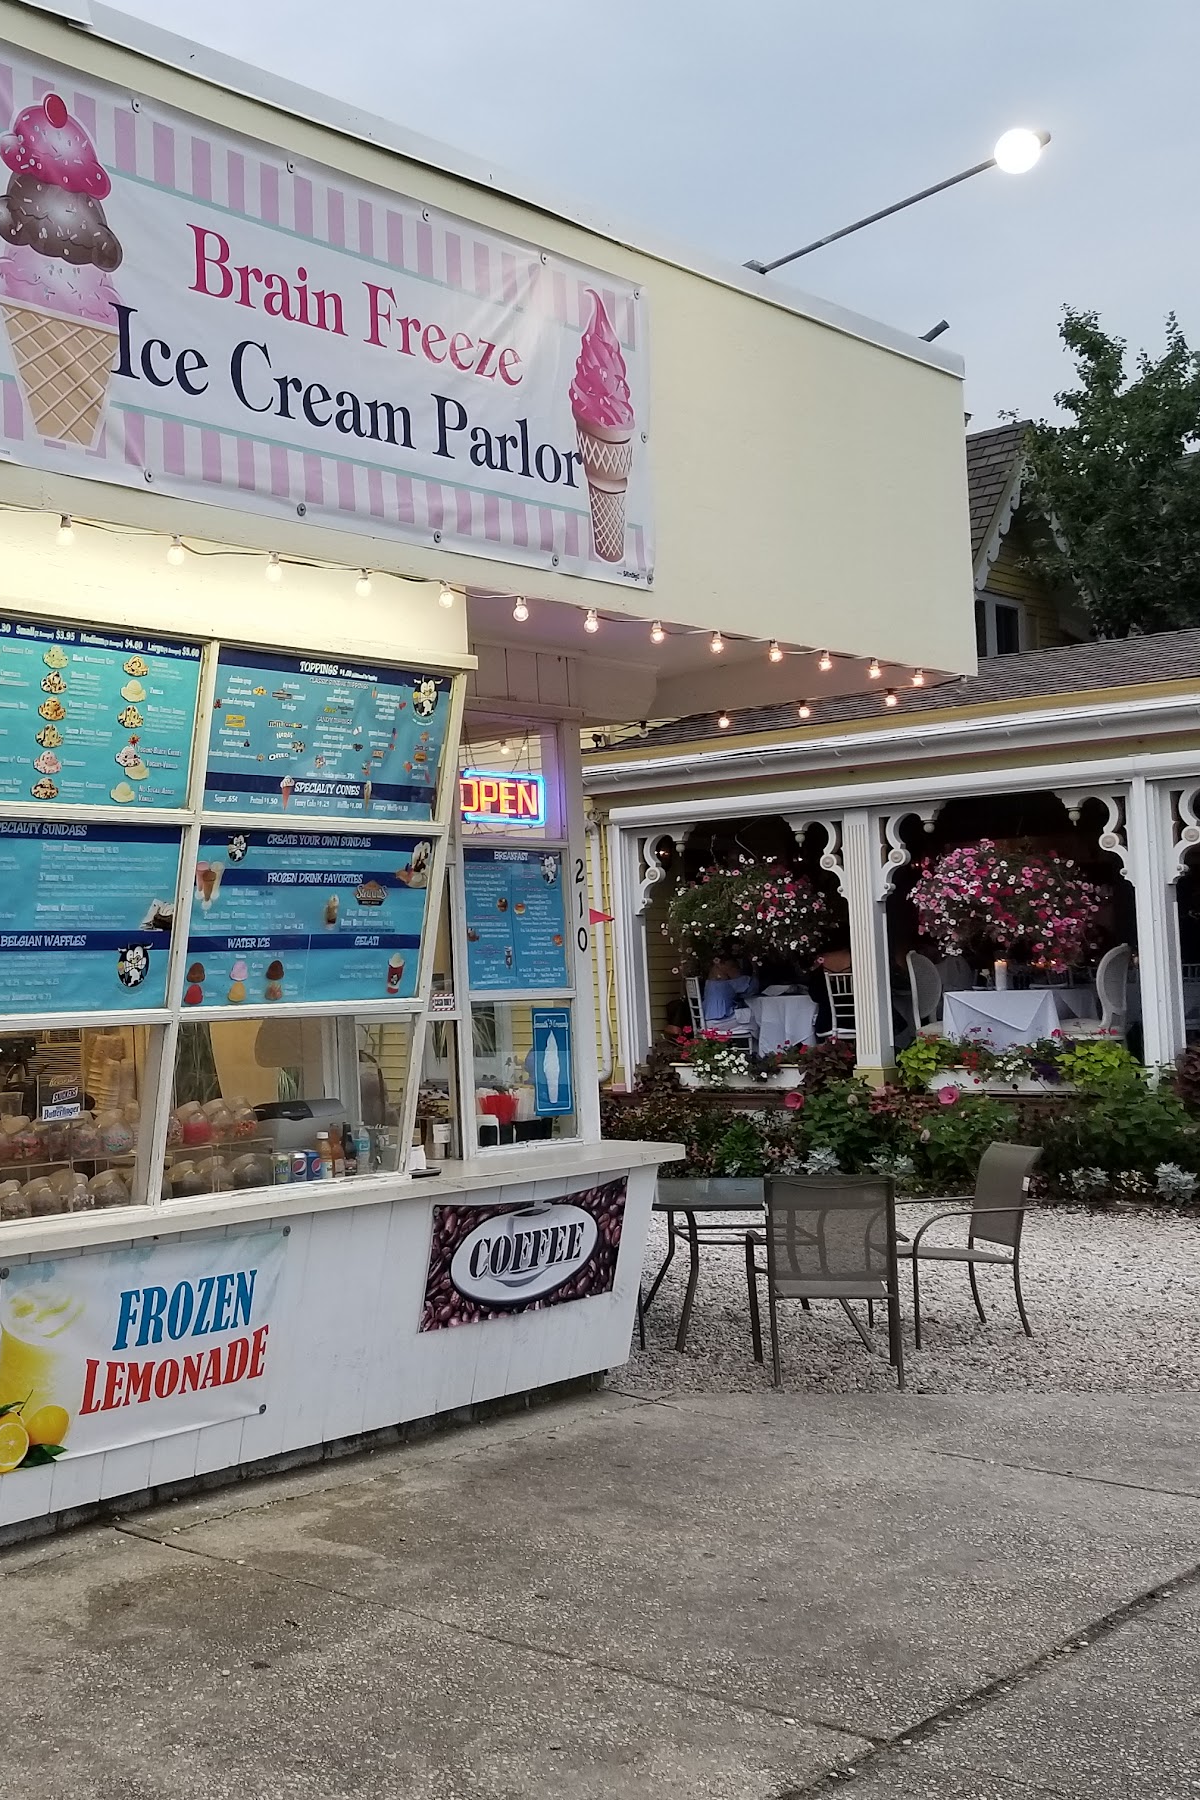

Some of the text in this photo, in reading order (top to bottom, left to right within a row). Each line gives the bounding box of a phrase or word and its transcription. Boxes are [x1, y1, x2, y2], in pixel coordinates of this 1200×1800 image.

[186, 223, 524, 386] Brain Freeze
[109, 302, 584, 490] Ice Cream Parlor
[300, 661, 338, 675] TOPPINGS
[268, 752, 289, 761] OREO
[294, 782, 360, 795] SPECIALTY CONES
[460, 779, 538, 815] OPEN
[42, 824, 87, 837] SUNDAES
[267, 834, 371, 847] CREATE YOUR OWN SUNDAE
[493, 851, 529, 861] BREAKFAST
[267, 873, 363, 884] FROZEN DRINK FAVORITES
[0, 935, 44, 947] BELGIAN
[44, 935, 86, 947] WAFFLES
[227, 937, 270, 949] WATER ICE
[354, 936, 379, 946] GELATI
[44, 1105, 80, 1119] Butterfinger
[468, 1222, 585, 1281] COFFEE
[113, 1269, 257, 1351] FROZEN
[78, 1325, 269, 1416] LEMONADE
